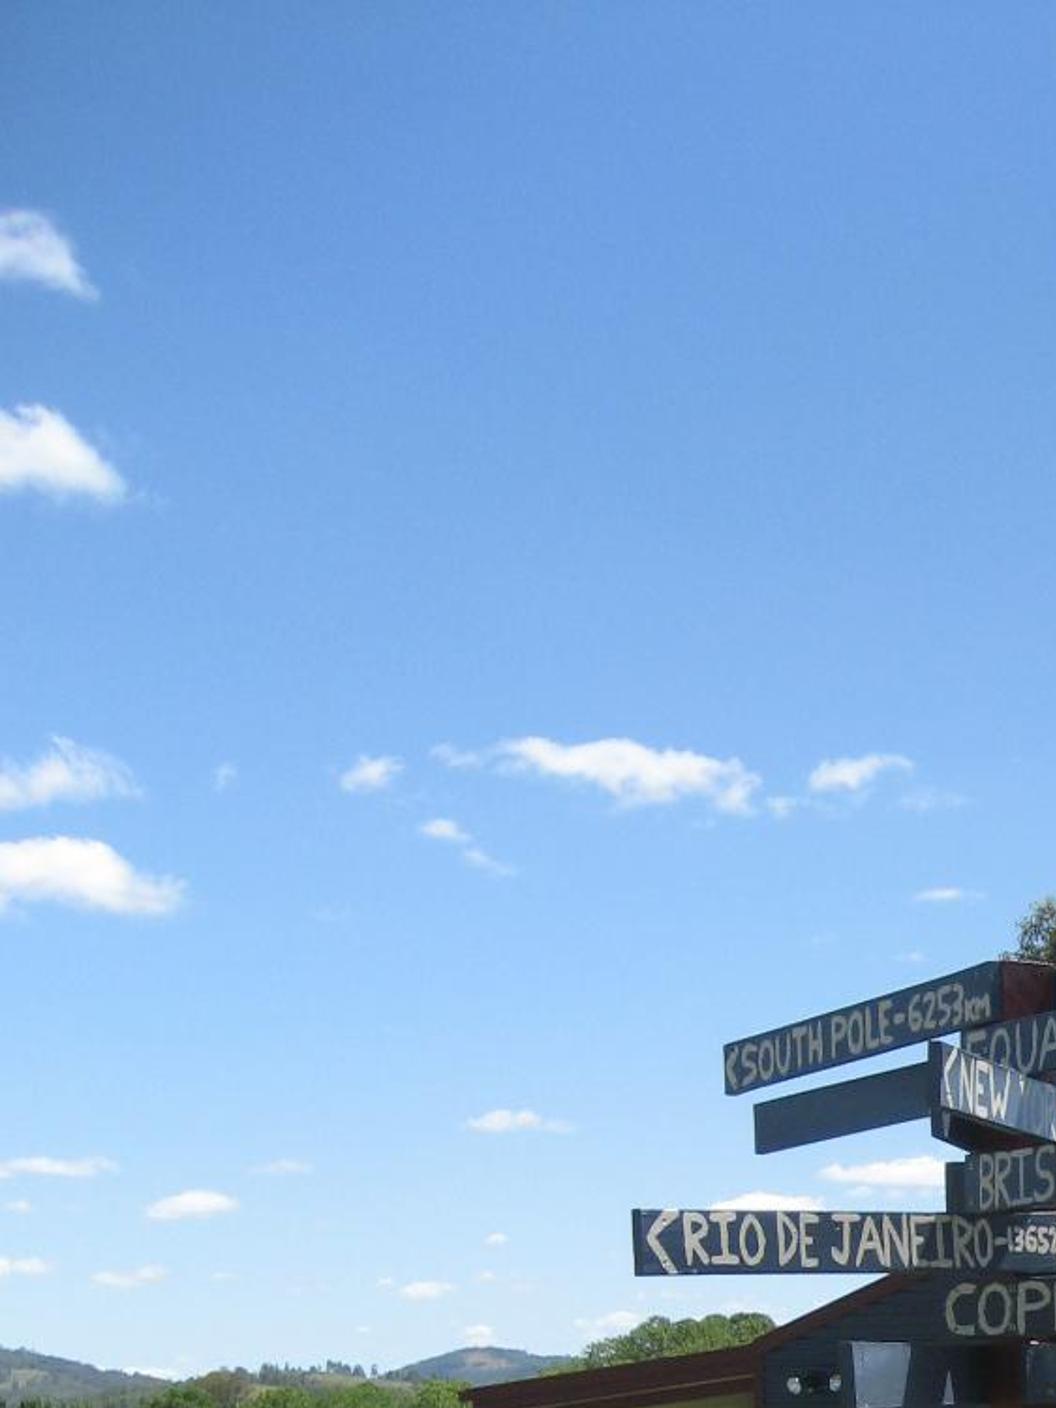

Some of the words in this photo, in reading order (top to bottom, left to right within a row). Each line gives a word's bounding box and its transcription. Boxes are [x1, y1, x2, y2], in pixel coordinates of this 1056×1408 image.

[740, 1029, 823, 1086] SOUTH
[958, 1052, 1011, 1121] NEW
[682, 1209, 767, 1267] RIO
[776, 1210, 819, 1268] DE
